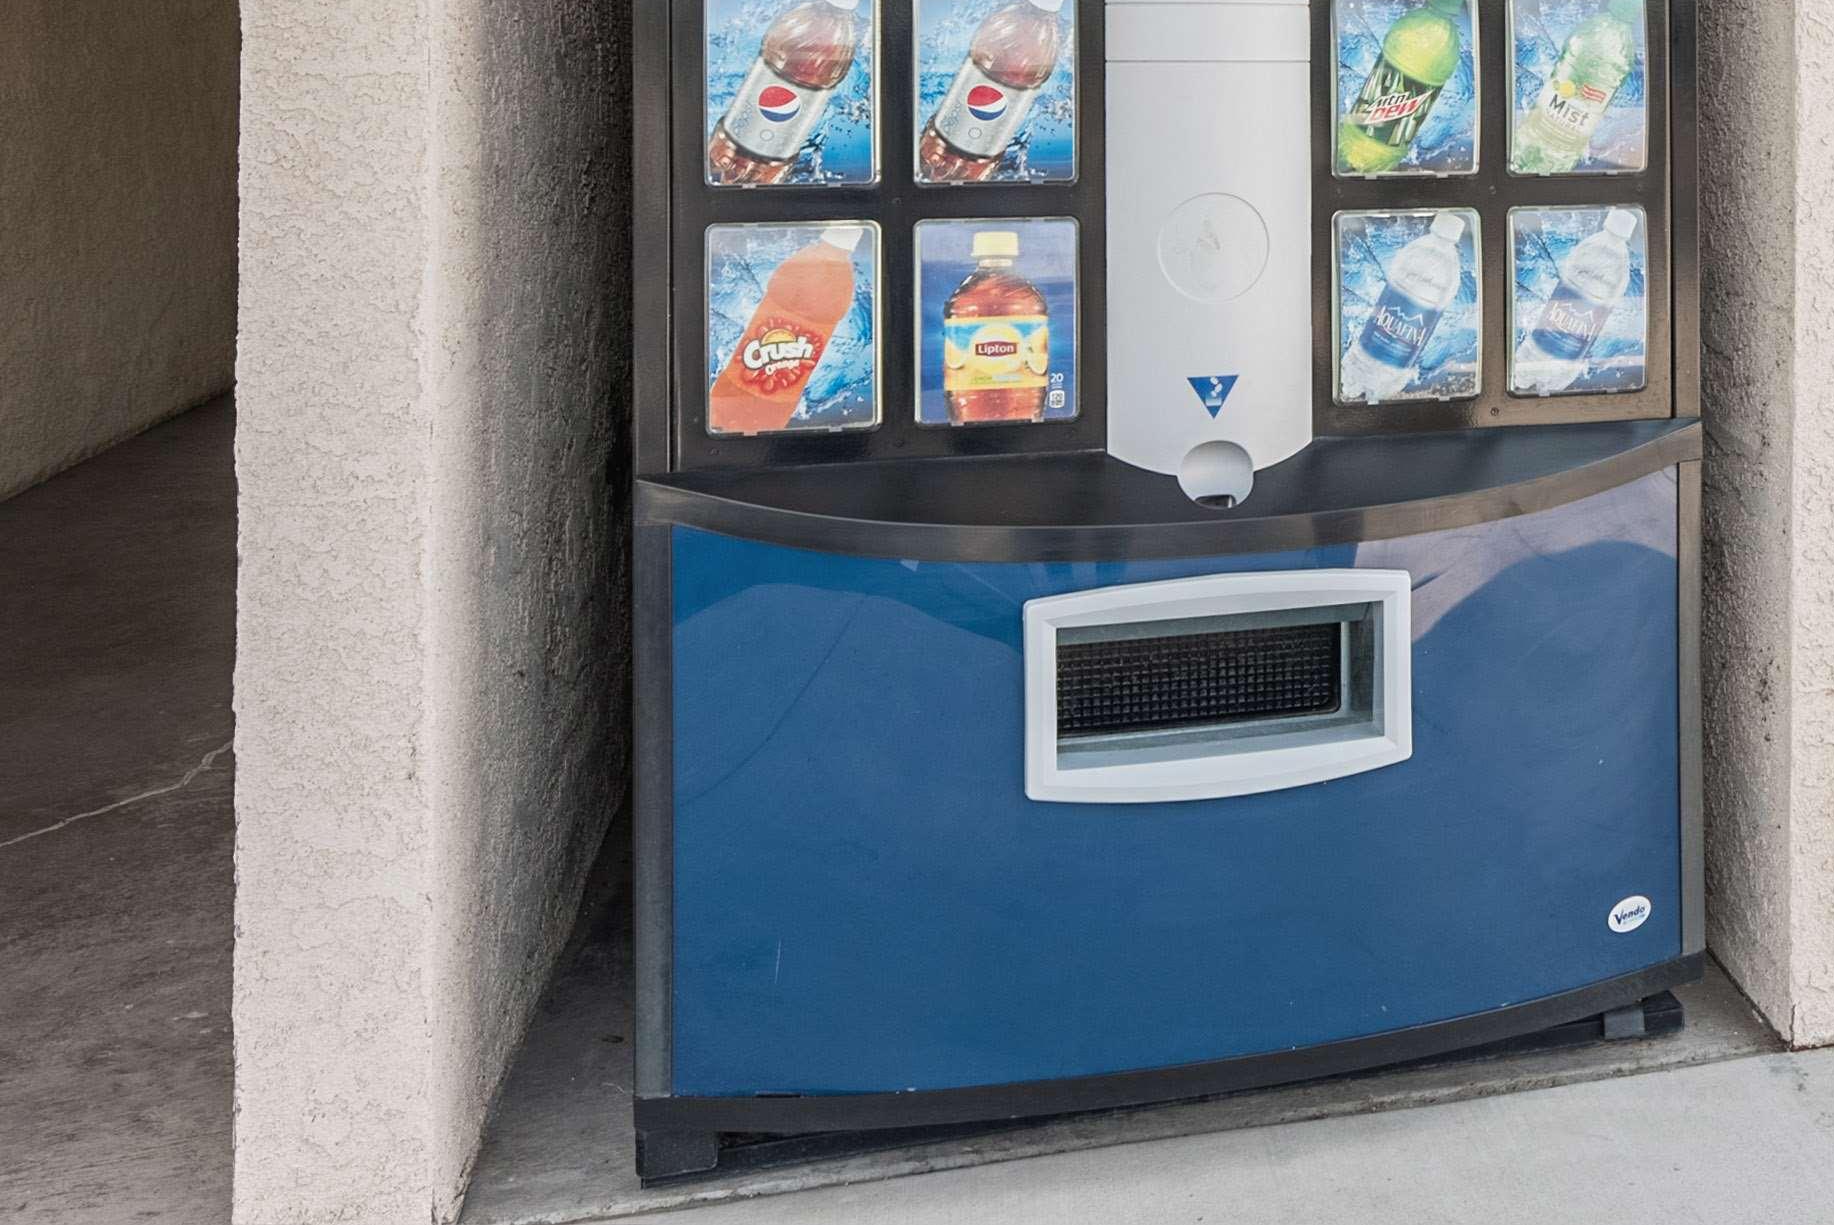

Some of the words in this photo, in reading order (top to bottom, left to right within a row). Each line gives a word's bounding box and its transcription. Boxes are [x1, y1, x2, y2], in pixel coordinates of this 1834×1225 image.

[1549, 93, 1589, 126] Mist
[743, 336, 814, 370] Crush
[977, 344, 1014, 354] Lipton
[1050, 373, 1064, 383] 20
[1614, 906, 1646, 925] Vendo
